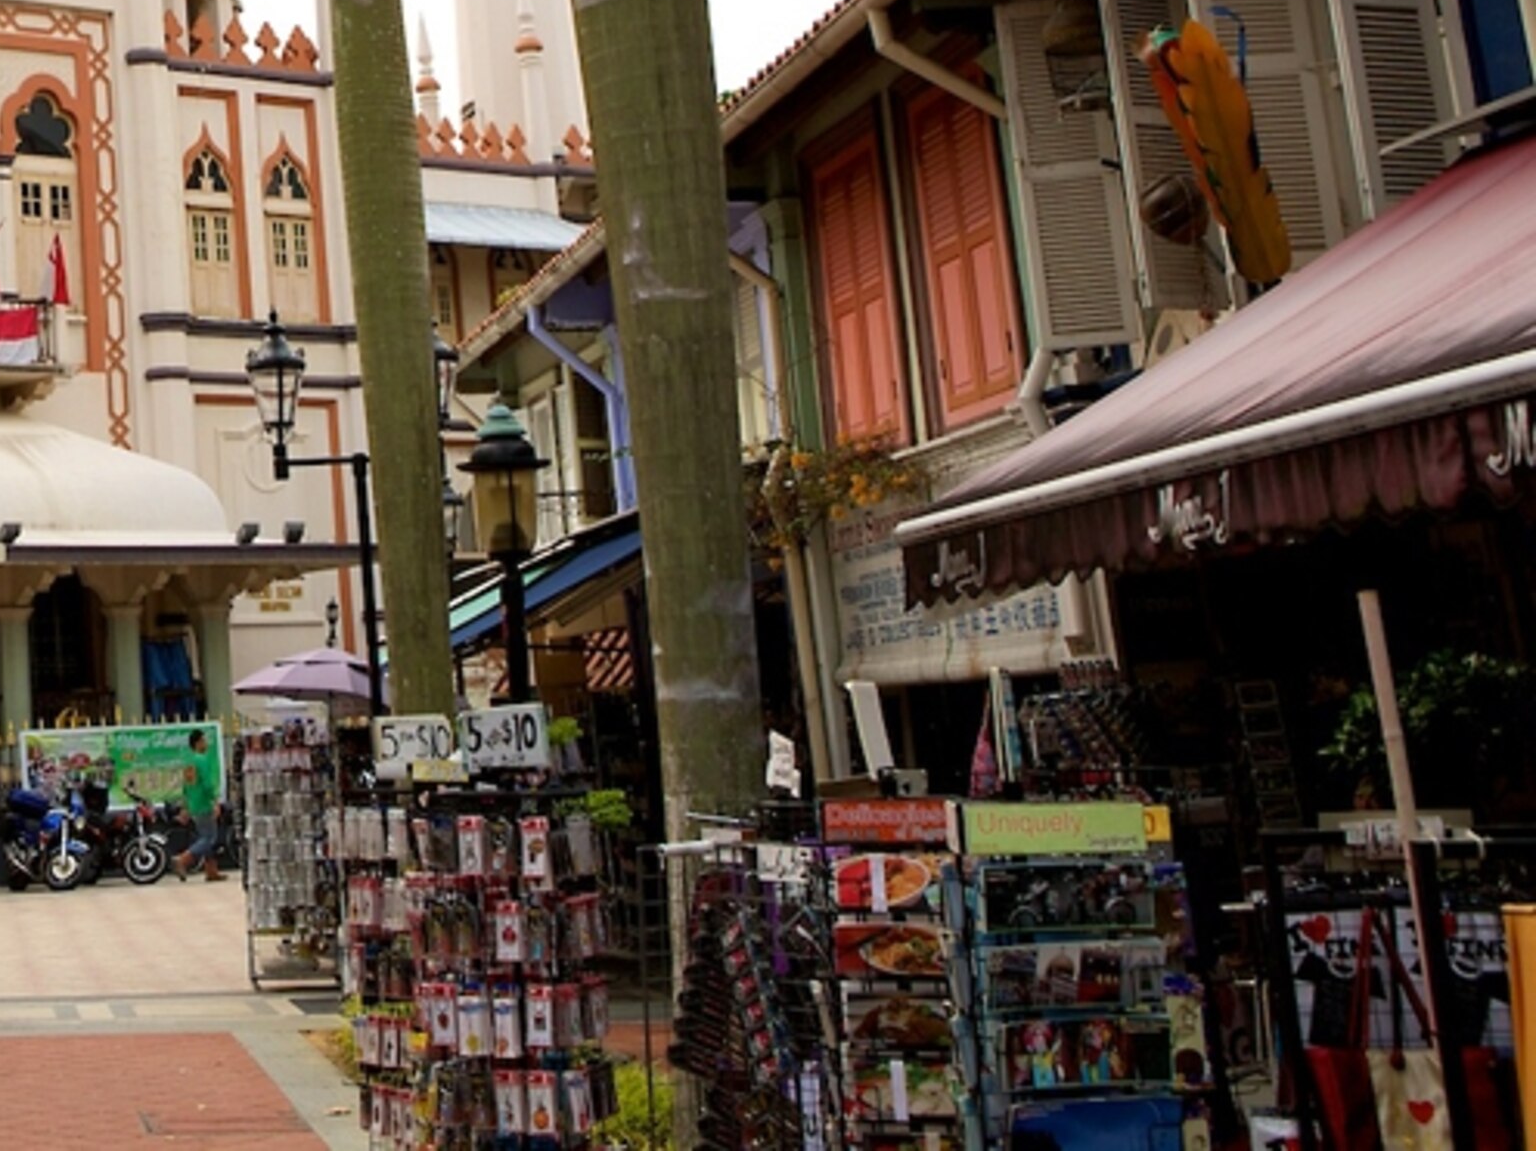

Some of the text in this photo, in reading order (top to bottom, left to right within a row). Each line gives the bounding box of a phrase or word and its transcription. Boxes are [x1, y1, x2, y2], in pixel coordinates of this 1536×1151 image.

[381, 725, 399, 760] 5
[467, 716, 482, 753] 5
[977, 811, 1084, 836] Uniquely
